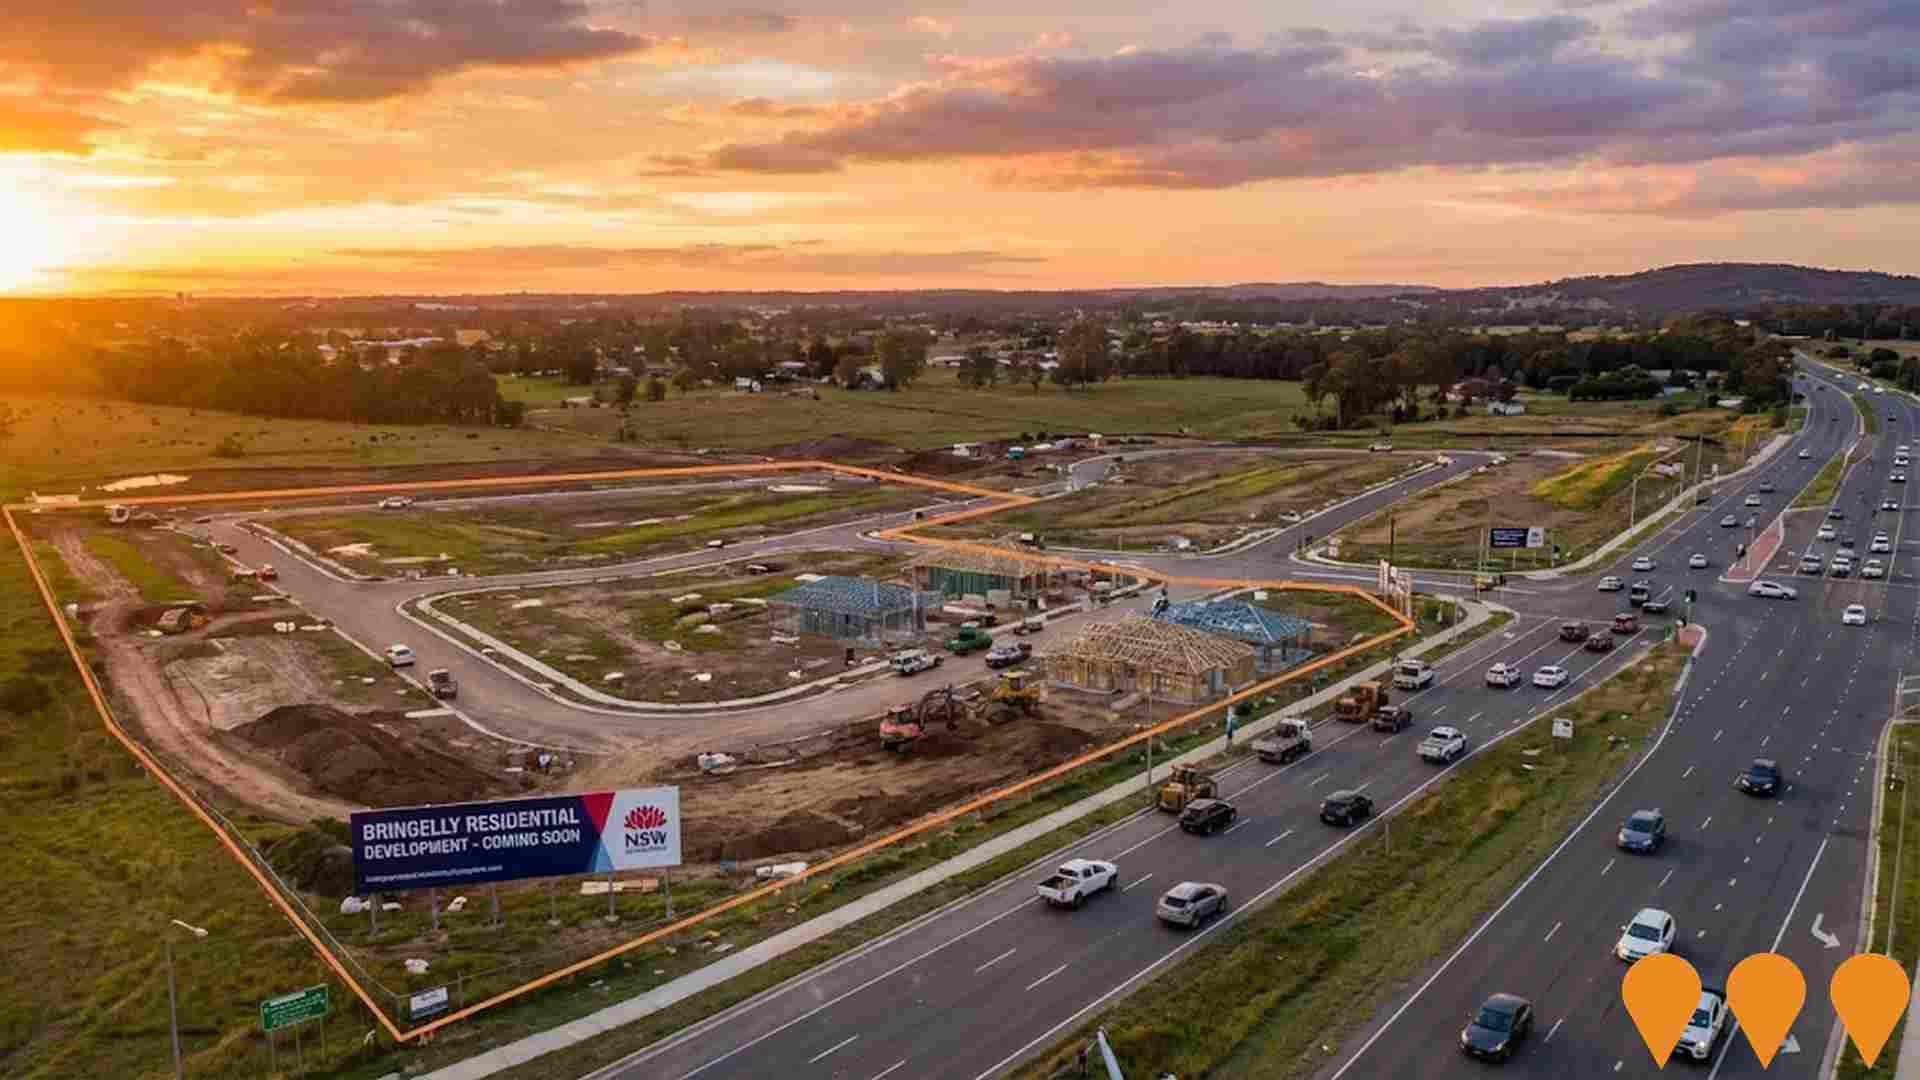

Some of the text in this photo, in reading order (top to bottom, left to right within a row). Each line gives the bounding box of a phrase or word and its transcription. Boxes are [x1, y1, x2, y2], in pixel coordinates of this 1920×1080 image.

[363, 807, 579, 841] BRINGELLY RESIDENTIAL
[625, 831, 667, 848] NSW
[364, 838, 468, 860] DEVELOPMENT
[482, 832, 538, 850] COMING
[542, 829, 581, 845] SOON
